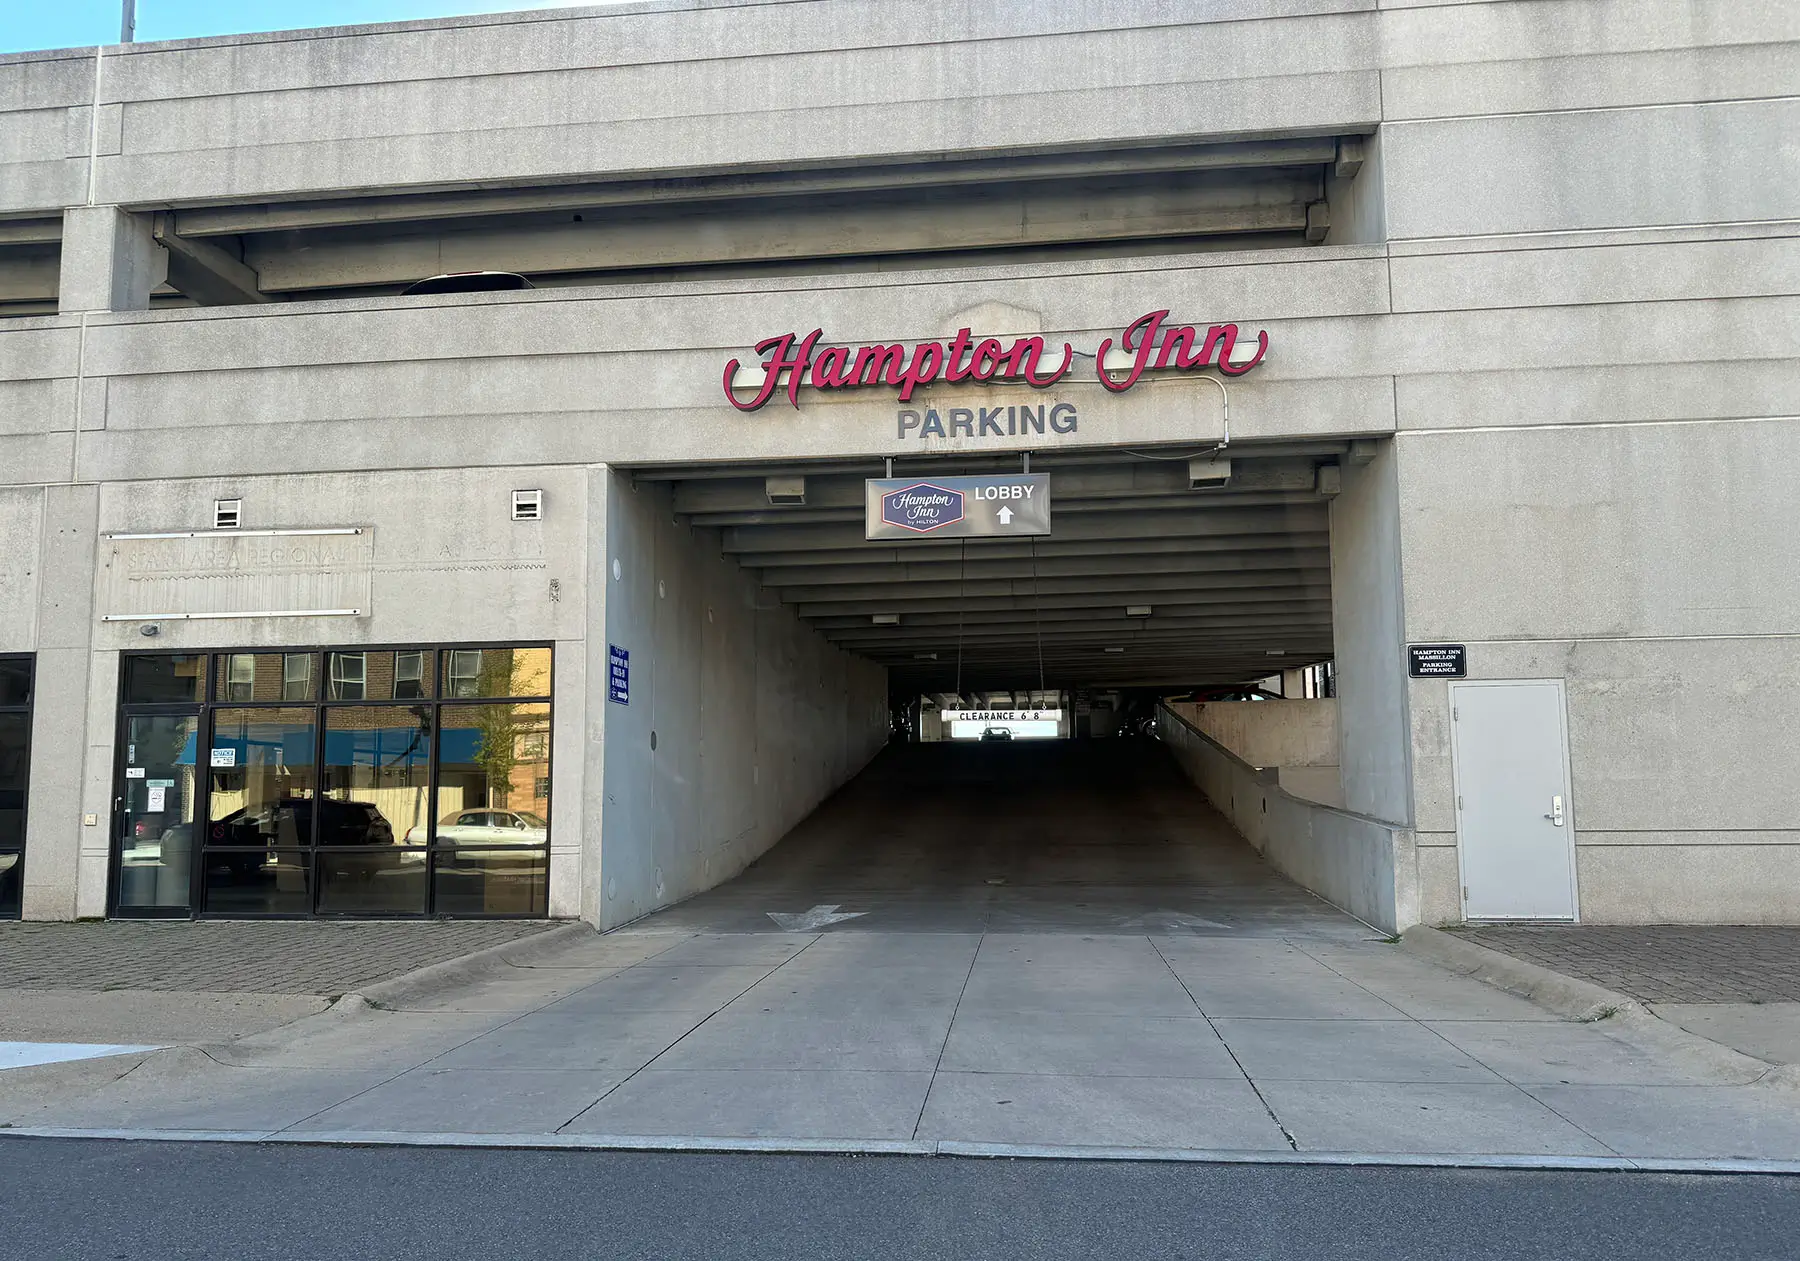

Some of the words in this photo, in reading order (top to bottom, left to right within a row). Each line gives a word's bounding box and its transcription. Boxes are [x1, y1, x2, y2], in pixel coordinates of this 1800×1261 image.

[722, 327, 1073, 412] Hampton
[1096, 309, 1269, 393] Inn
[898, 403, 1078, 440] PARKING
[975, 485, 1035, 500] LOBBY
[892, 492, 954, 510] Hampton
[906, 504, 940, 519] Inn
[959, 712, 1015, 720] CLEARANCE
